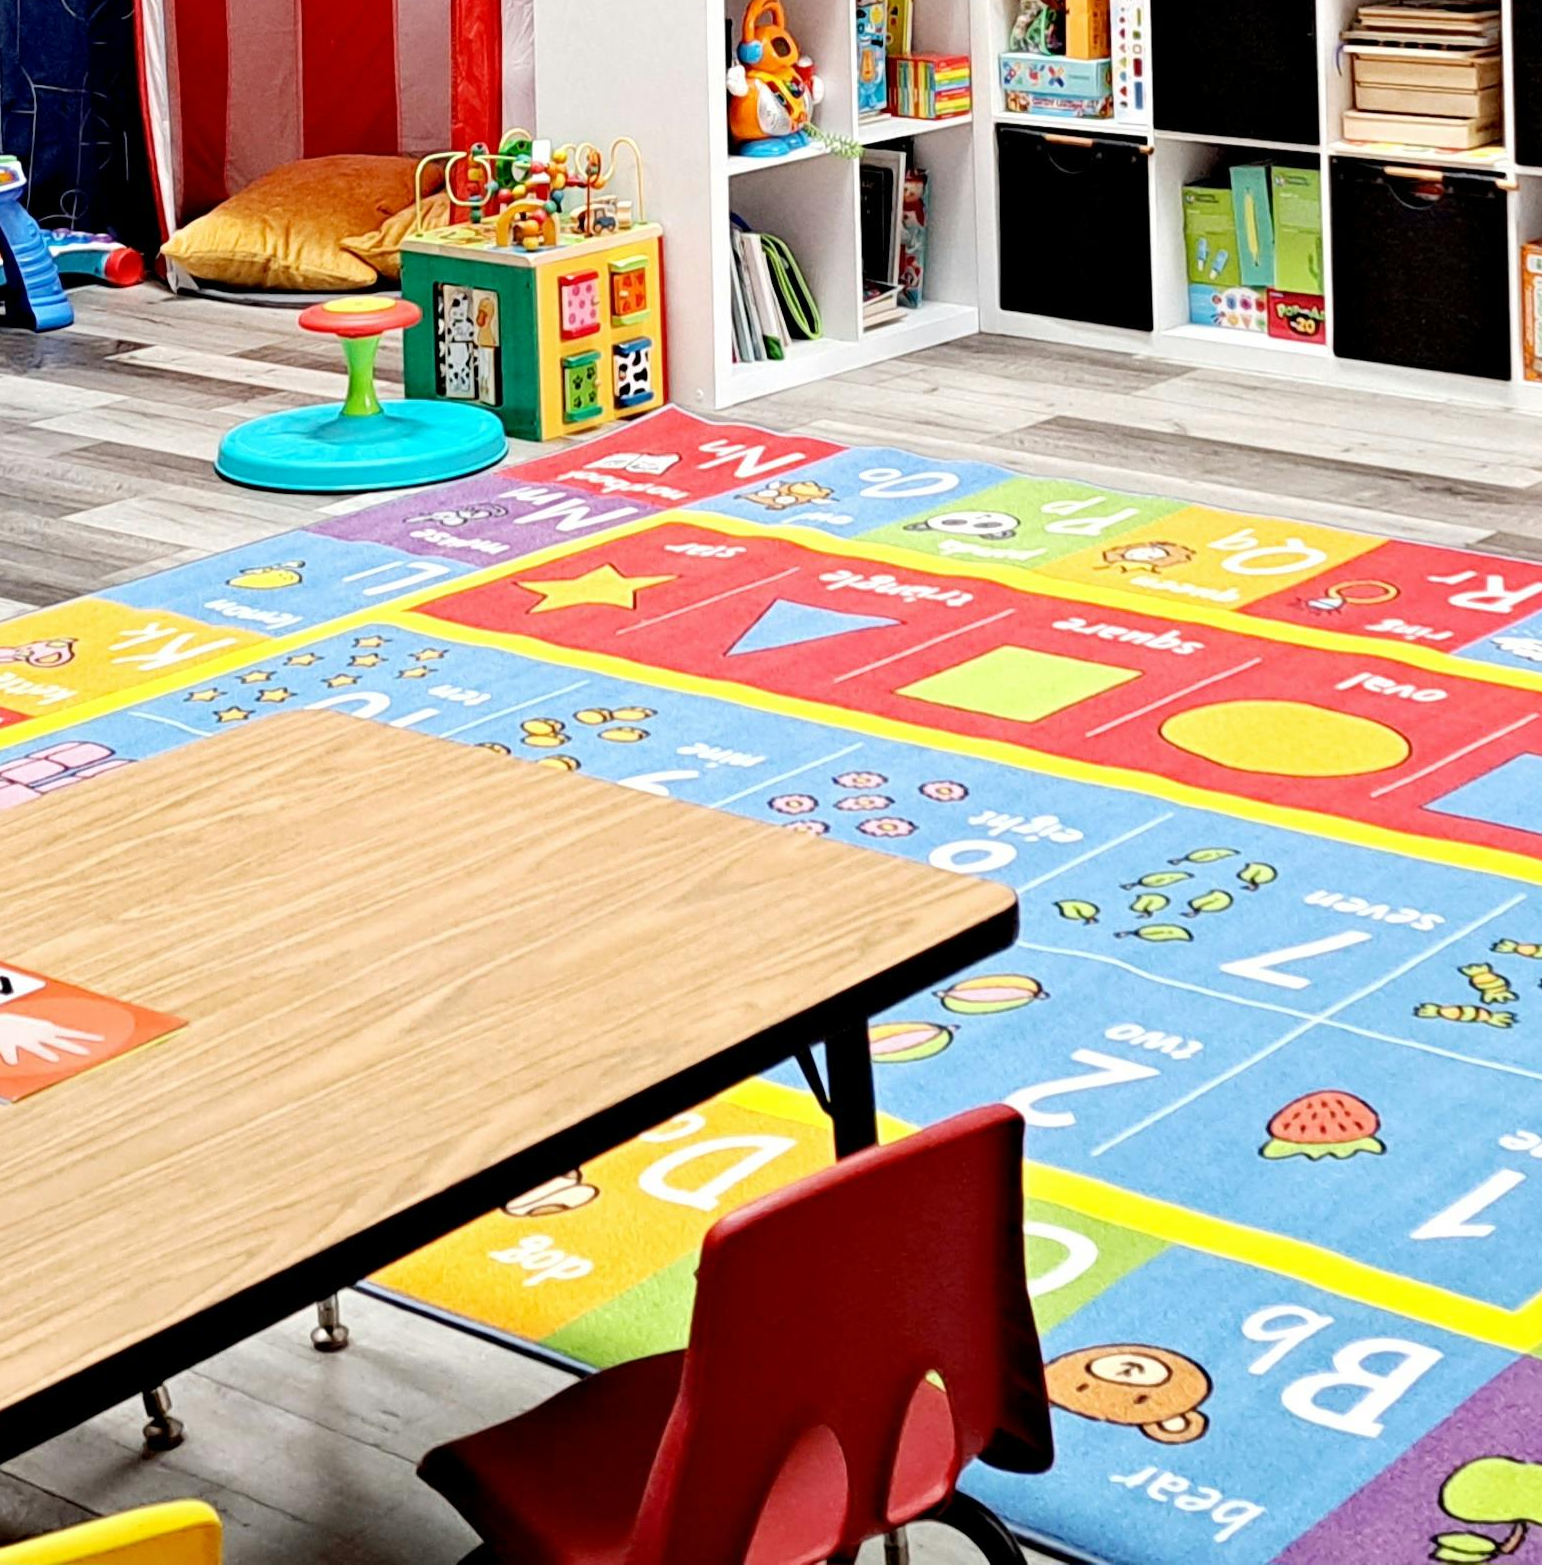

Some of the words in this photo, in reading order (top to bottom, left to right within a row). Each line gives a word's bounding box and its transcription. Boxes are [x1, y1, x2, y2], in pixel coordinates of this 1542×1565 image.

[698, 440, 805, 478] Nn
[1041, 496, 1138, 536] Pp
[409, 528, 510, 555] mouse
[665, 543, 746, 558] star
[1210, 519, 1329, 575] Qq
[342, 561, 452, 597] Ll
[820, 570, 973, 606] triangle
[204, 599, 303, 630] lemon
[1367, 619, 1452, 640] ring
[112, 623, 236, 671] Kk
[1053, 618, 1203, 654] square
[1337, 673, 1447, 702] oval
[676, 742, 767, 769] nine
[968, 810, 1084, 843] eight
[1304, 890, 1445, 931] seven
[1219, 930, 1372, 990] 7
[1105, 1023, 1203, 1060] two
[1001, 1048, 1160, 1128] 2
[1410, 1168, 1525, 1240] 1
[491, 1235, 592, 1285] dog
[1242, 1305, 1443, 1438] Bb
[1110, 1467, 1265, 1543] bear
